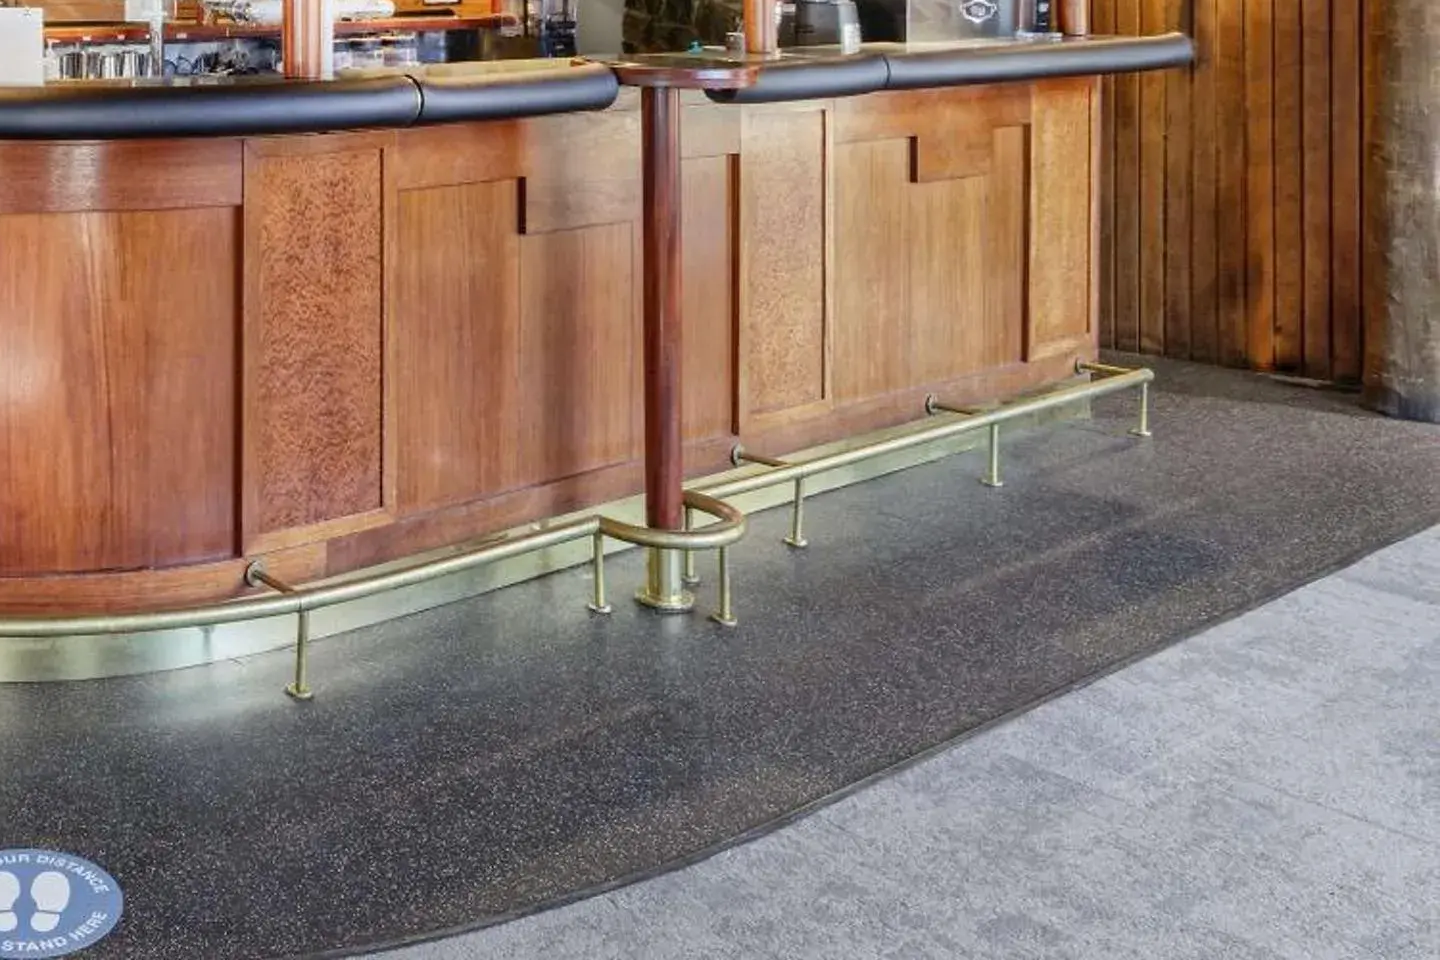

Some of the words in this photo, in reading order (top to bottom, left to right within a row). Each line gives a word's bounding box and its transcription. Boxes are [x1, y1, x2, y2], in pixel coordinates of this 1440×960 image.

[36, 855, 110, 893] DISTANCE
[1, 936, 67, 952] STAND
[68, 911, 107, 940] HERE
